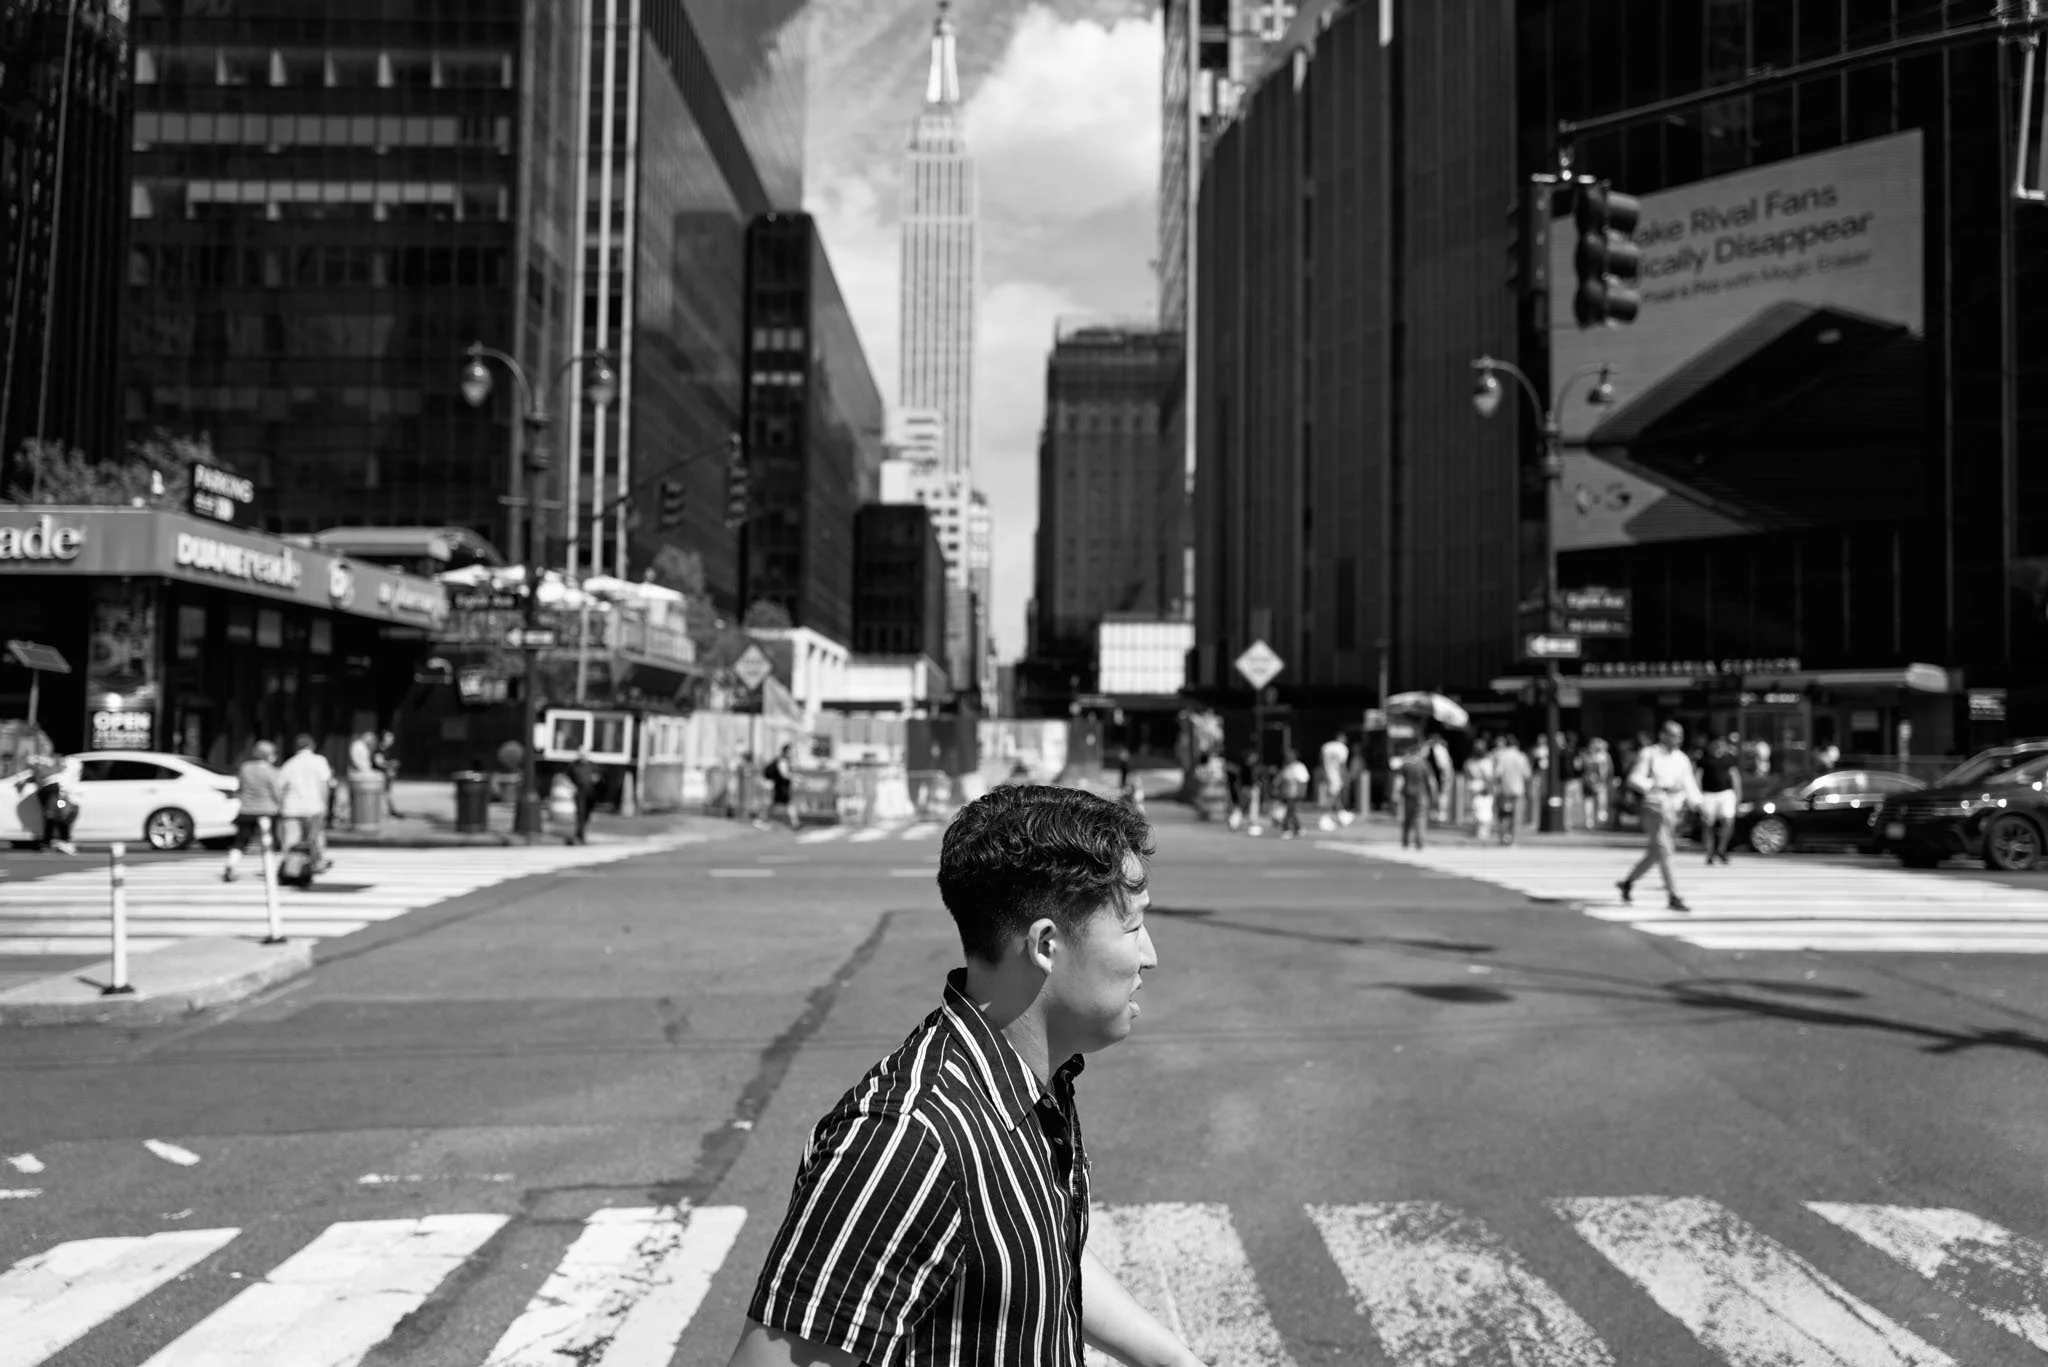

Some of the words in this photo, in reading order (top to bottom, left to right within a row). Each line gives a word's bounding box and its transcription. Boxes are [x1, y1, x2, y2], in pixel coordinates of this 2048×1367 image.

[1634, 219, 1685, 248] ake
[1690, 196, 1758, 236] Rival
[1764, 183, 1838, 220] Fans
[1639, 247, 1710, 277] ically
[1714, 210, 1875, 265] Disappear
[194, 464, 254, 503] PARKING
[94, 711, 152, 731] OPEN
